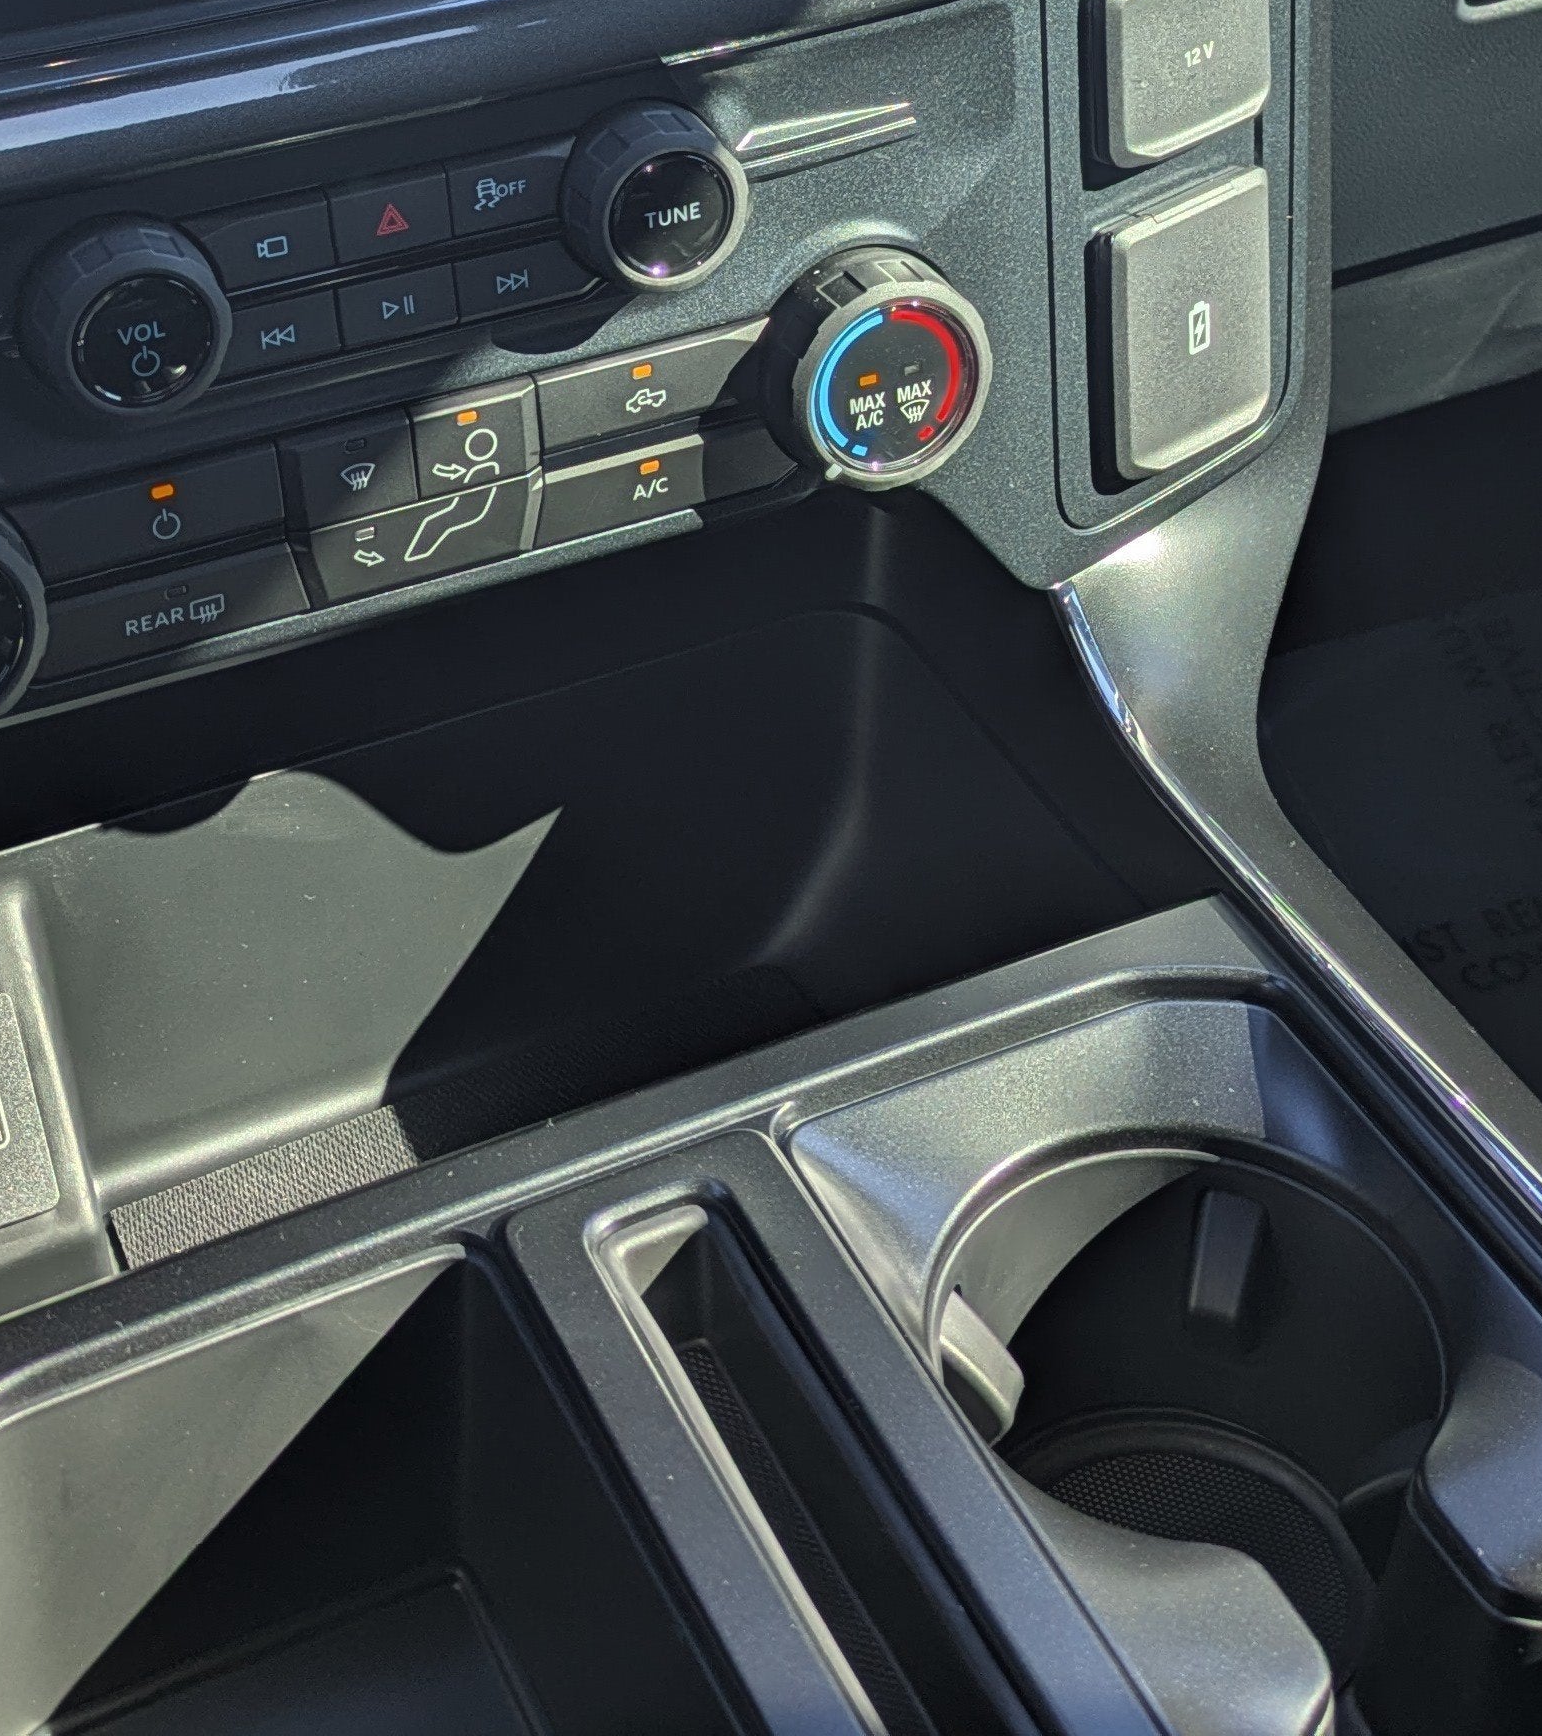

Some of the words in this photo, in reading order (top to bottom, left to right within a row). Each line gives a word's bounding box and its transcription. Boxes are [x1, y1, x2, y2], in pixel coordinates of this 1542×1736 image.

[497, 178, 528, 199] OFF
[645, 202, 702, 229] TUNE
[118, 322, 166, 345] VOL
[850, 391, 886, 415] MAX
[896, 379, 933, 404] MAX
[856, 408, 884, 430] A/C
[634, 477, 670, 502] A/C
[125, 607, 185, 637] REAR
